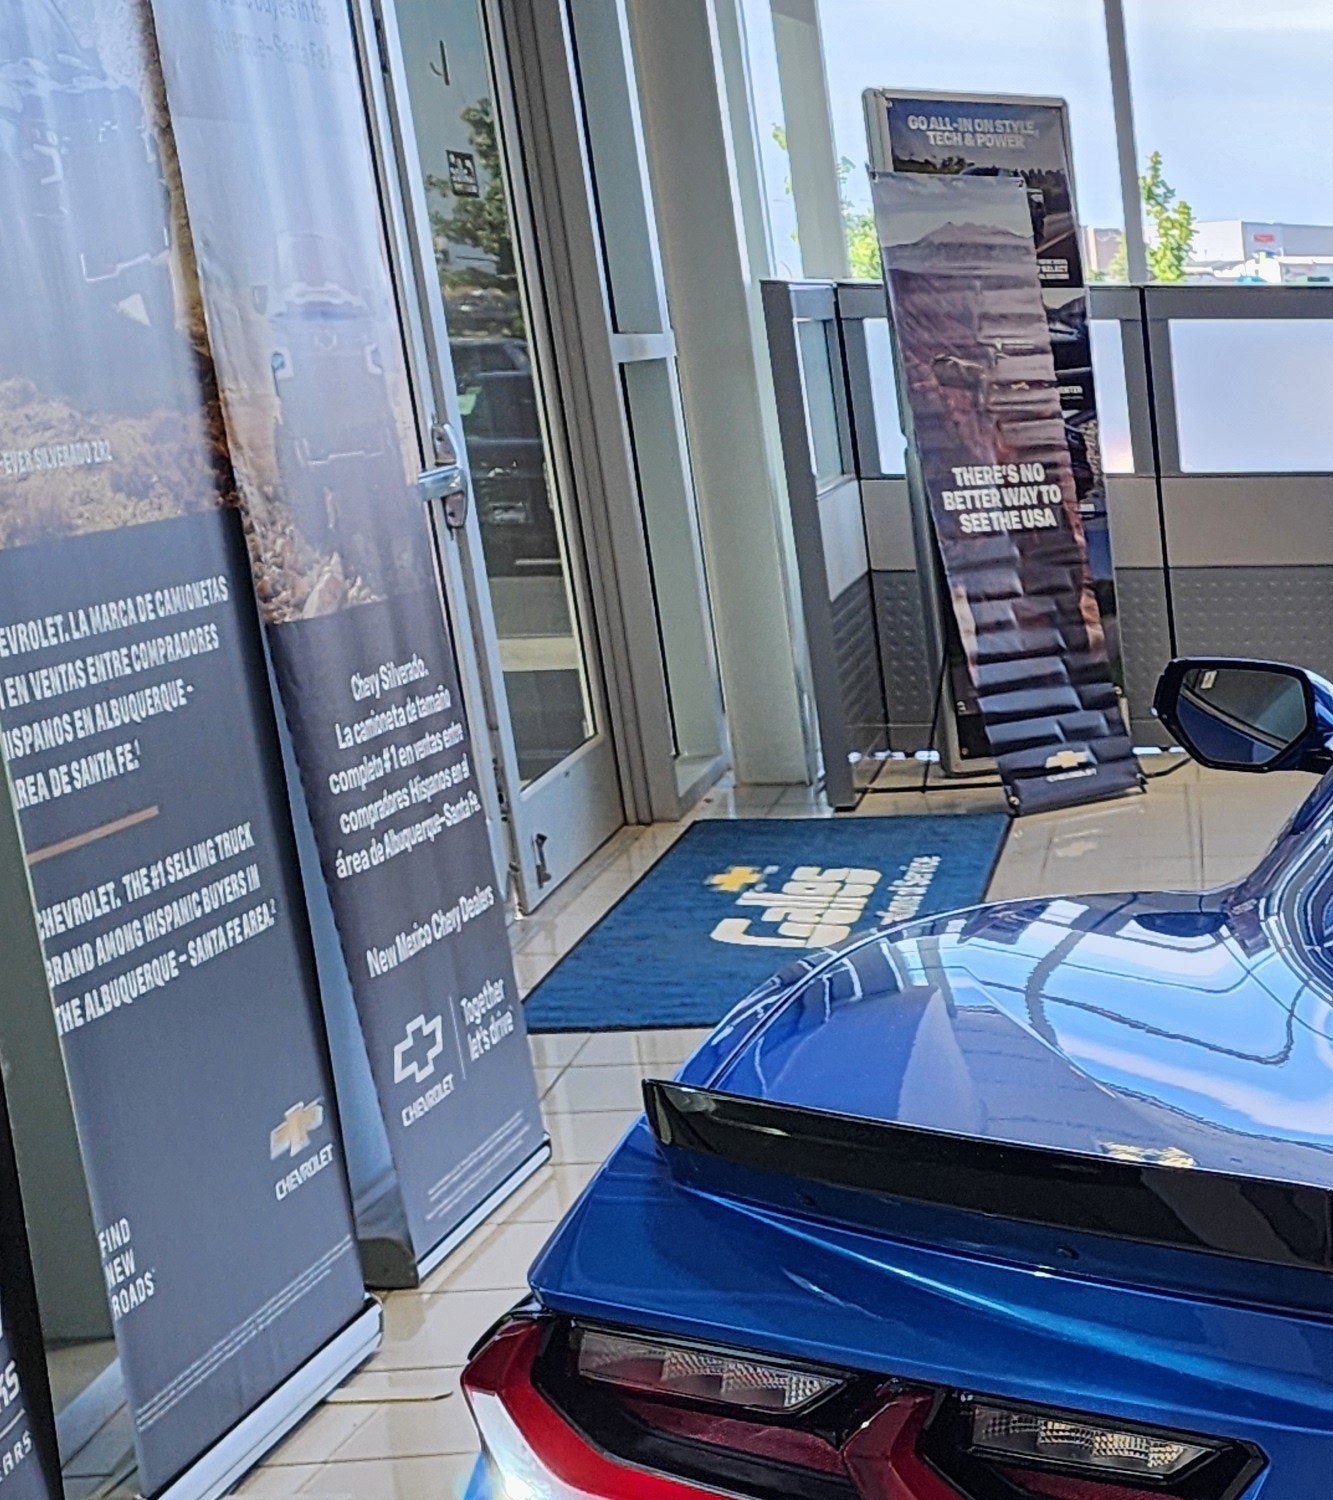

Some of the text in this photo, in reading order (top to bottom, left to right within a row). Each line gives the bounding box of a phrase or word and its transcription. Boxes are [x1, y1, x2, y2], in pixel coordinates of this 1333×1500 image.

[907, 114, 929, 131] GO
[929, 116, 974, 132] ALL-IN
[975, 117, 994, 133] ON
[927, 132, 1026, 149] TECH & POWER
[33, 441, 92, 471] SILVERADO
[951, 463, 1045, 487] THERE'S NO
[942, 484, 1062, 511] BETTER WAY TO
[959, 507, 1057, 534] SEE THE USA
[68, 609, 90, 640] LA
[89, 597, 138, 635] MARCA
[136, 592, 154, 623] DE
[154, 575, 229, 618] CAMIONETAS
[4, 675, 31, 708] EN
[28, 658, 87, 701] VENTAS
[86, 648, 132, 685] ENTRE
[130, 623, 220, 672] COMPRADORES
[350, 653, 430, 701] Chevy Silverado.
[73, 707, 96, 740] EN
[95, 678, 187, 732] ALBUQUERQUE
[335, 684, 450, 749] La camioneta de tamaño
[48, 763, 73, 798] DE
[71, 749, 118, 789] SANTA
[329, 753, 384, 795] completo
[382, 744, 399, 774] #1
[398, 743, 414, 767] en
[413, 732, 443, 761] ventas
[339, 785, 410, 834] compradores
[408, 774, 453, 804] Hispanos
[451, 762, 464, 784] en
[36, 821, 255, 940] CHEVROLET. THE #1 SELLING TRUCK
[335, 849, 371, 879] área
[369, 839, 385, 866] de
[46, 863, 261, 988] BRAND AMONG HISPANIC BUYERS IN
[366, 885, 495, 978] New Mexico Chevy Dealers
[54, 916, 243, 1036] THE ALBUQUERQUE SANTA FE
[460, 978, 505, 1026] Together
[467, 1025, 491, 1062] let's
[401, 1073, 455, 1128] CHEVROLET
[275, 1142, 335, 1201] CHEVROLET
[98, 1217, 131, 1258] FIND
[104, 1248, 136, 1288] NEW
[110, 1271, 154, 1320] ROADS
